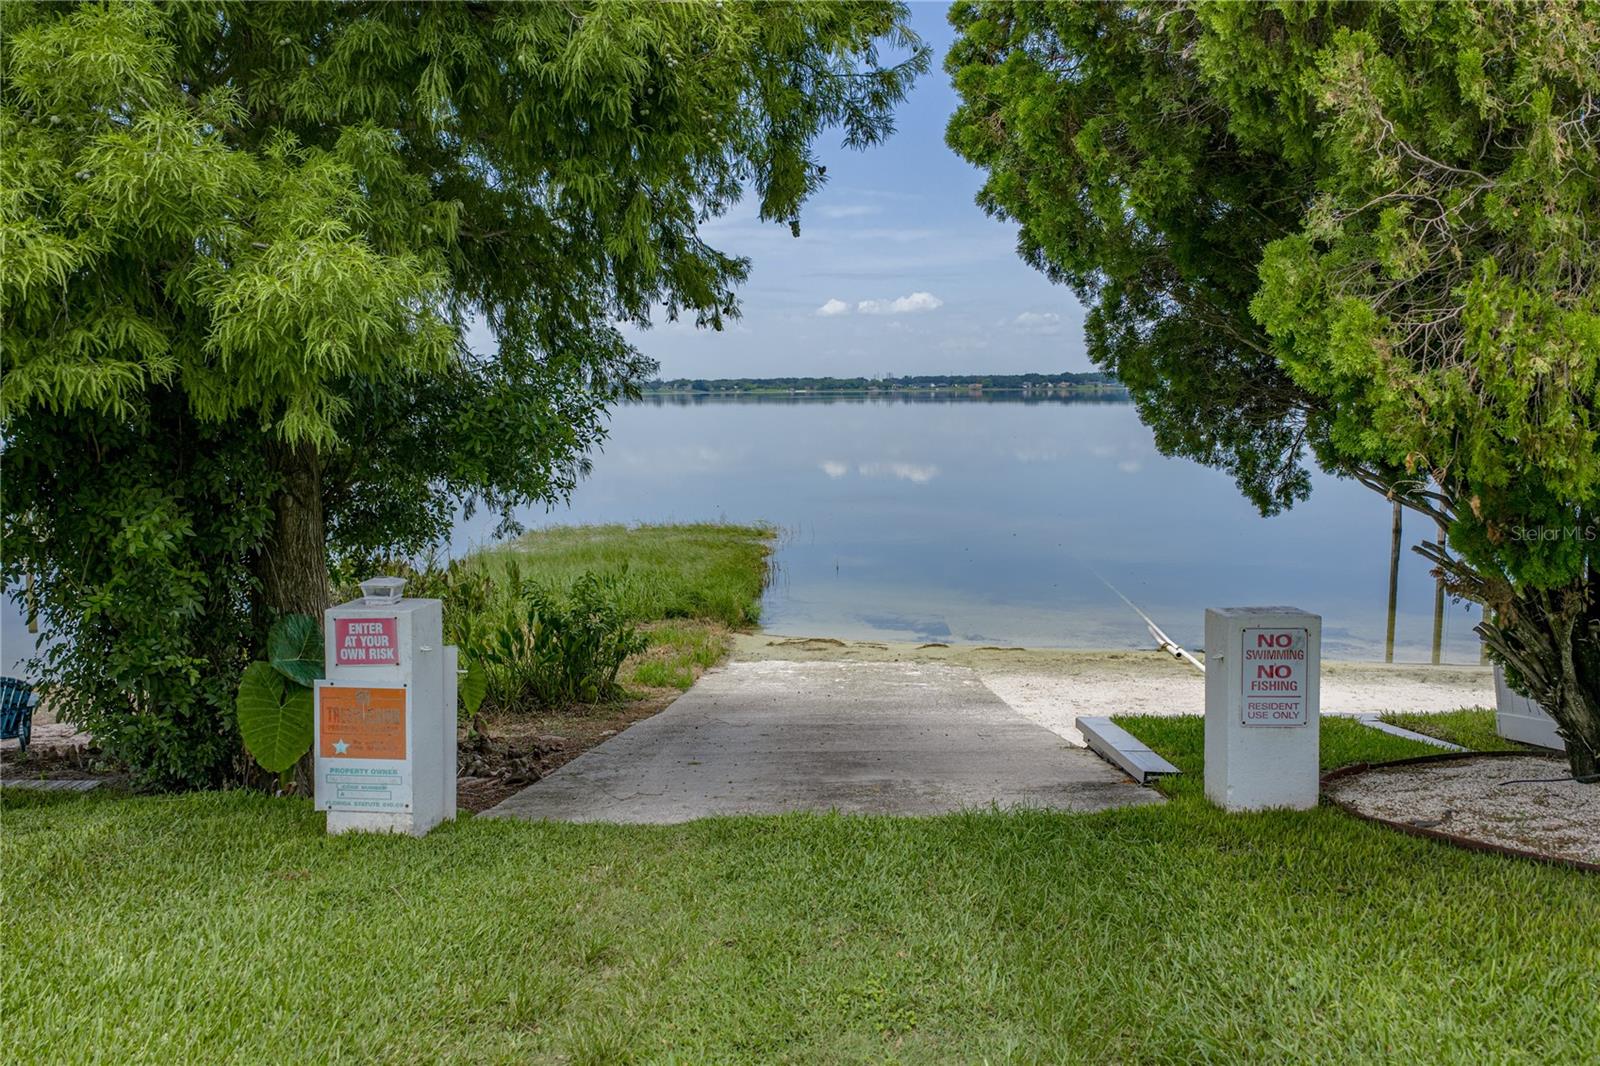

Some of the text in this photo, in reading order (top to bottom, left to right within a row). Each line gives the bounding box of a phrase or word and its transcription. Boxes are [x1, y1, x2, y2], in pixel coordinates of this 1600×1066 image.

[348, 623, 383, 634] ENTER
[344, 636, 389, 647] AT YOUR
[1257, 634, 1293, 648] NO
[340, 648, 394, 659] OWN RISK
[1246, 649, 1304, 660] SWIMMING
[1257, 664, 1292, 679] NO
[1251, 680, 1298, 691] FISHING
[1248, 702, 1300, 710] RESIDENT
[1247, 711, 1300, 719] USE ONLY
